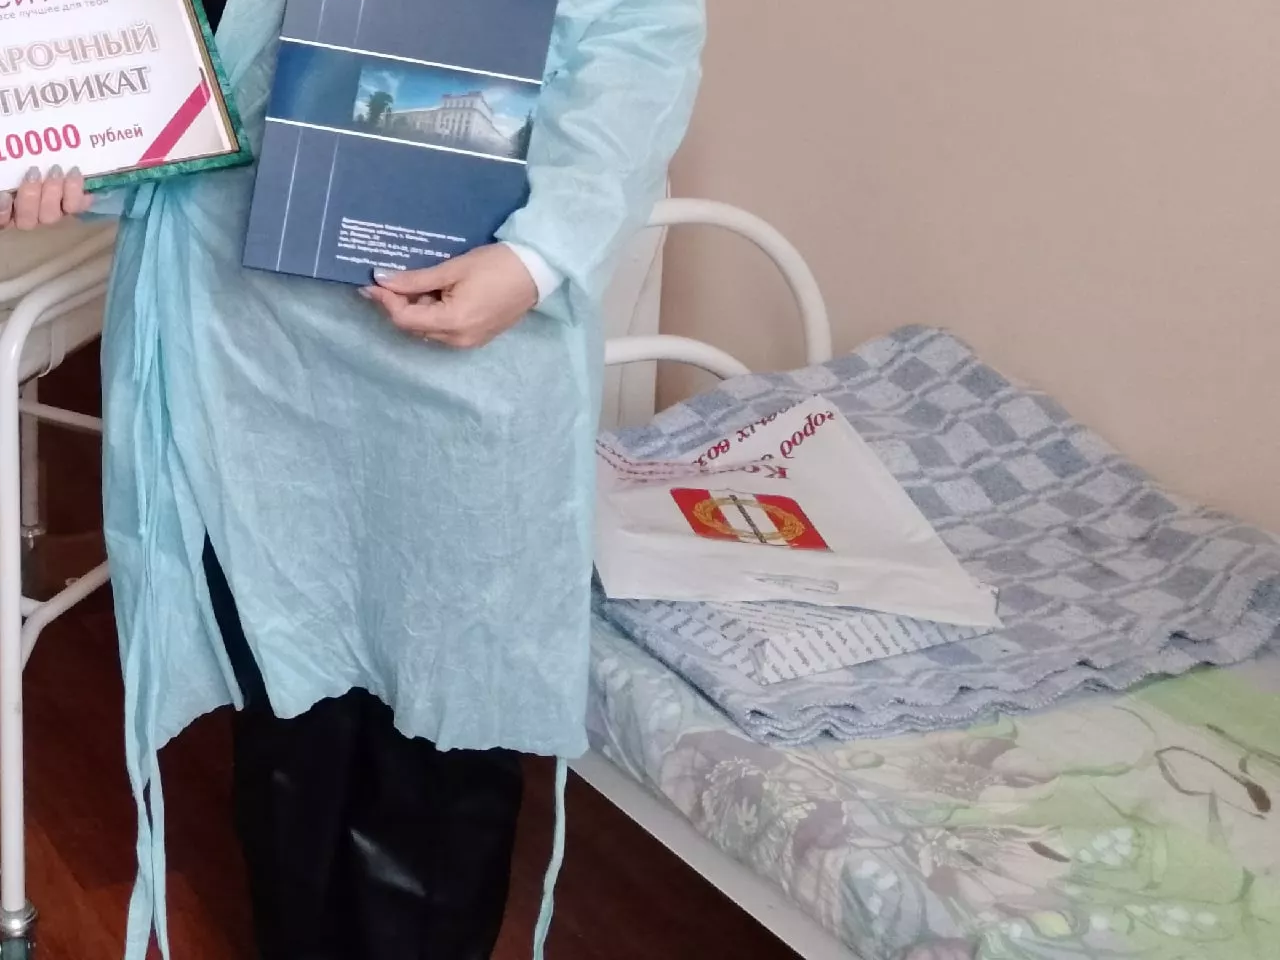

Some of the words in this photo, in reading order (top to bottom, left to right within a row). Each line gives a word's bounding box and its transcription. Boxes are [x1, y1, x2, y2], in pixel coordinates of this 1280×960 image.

[19, 5, 61, 20] лучшее
[62, 0, 82, 13] для
[89, 124, 144, 149] рублей
